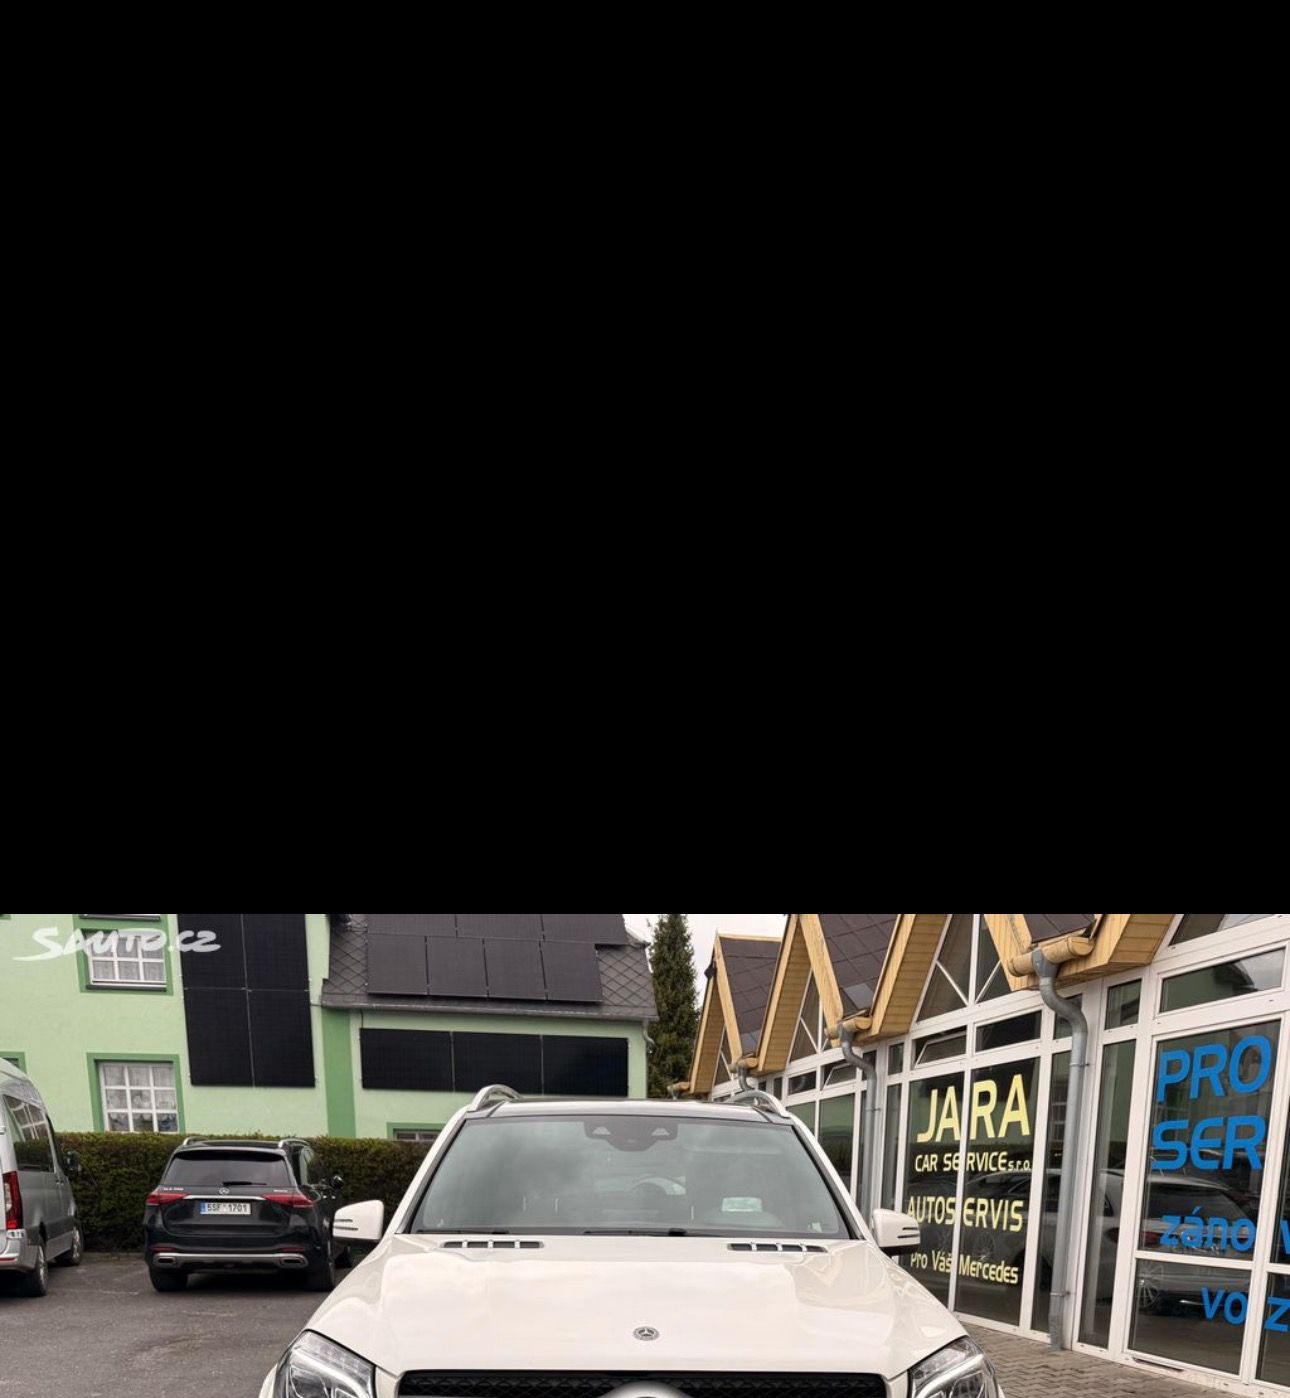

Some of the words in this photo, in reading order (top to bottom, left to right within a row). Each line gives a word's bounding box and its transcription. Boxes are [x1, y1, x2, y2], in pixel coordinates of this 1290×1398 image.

[1156, 1035, 1272, 1102] PRO
[917, 1074, 1030, 1142] JARA
[915, 1154, 938, 1172] CAR
[943, 1151, 1008, 1172] SERVICE
[1151, 1115, 1266, 1170] SER
[907, 1196, 1024, 1232] AUTOSERVIS
[910, 1252, 928, 1269] Pro
[958, 1253, 1019, 1284] Mercedes
